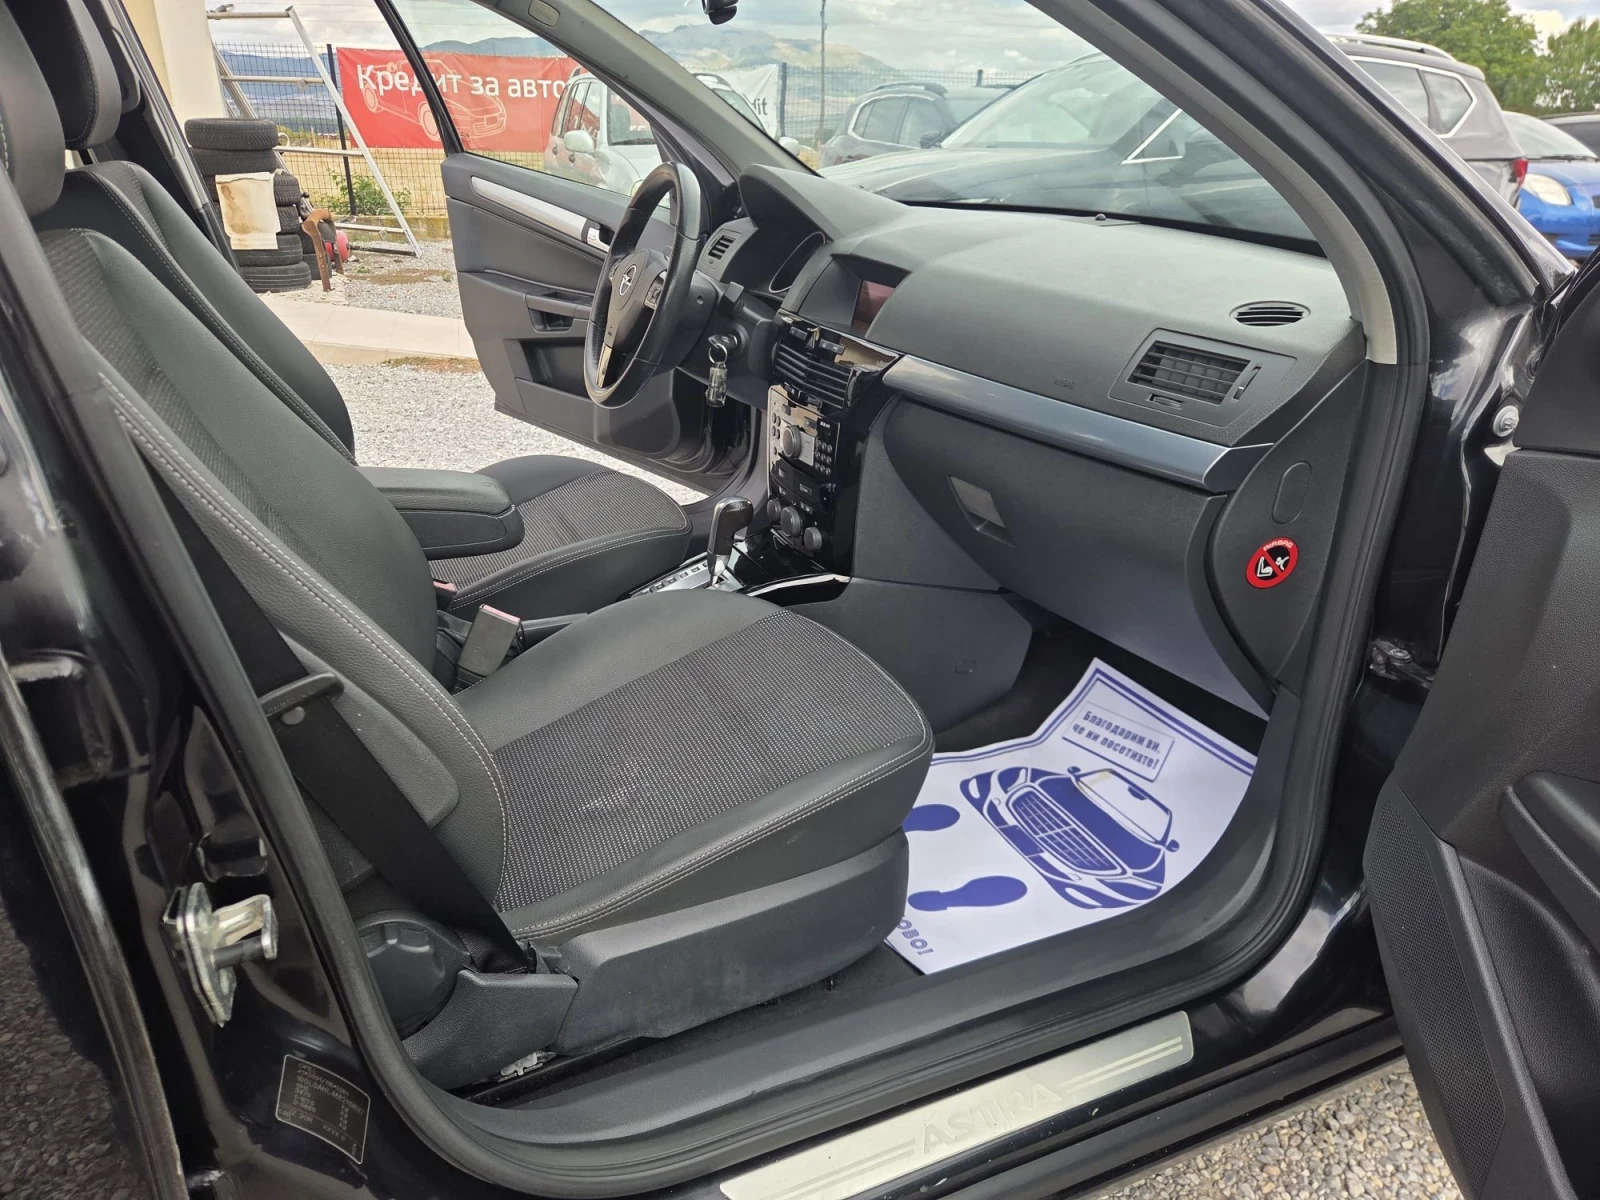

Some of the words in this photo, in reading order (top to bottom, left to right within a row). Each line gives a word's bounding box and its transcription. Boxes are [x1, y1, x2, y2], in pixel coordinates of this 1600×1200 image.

[471, 76, 499, 97] за
[1072, 723, 1086, 735] че
[1085, 729, 1101, 743] ни
[922, 1082, 1063, 1154] ASTRA
